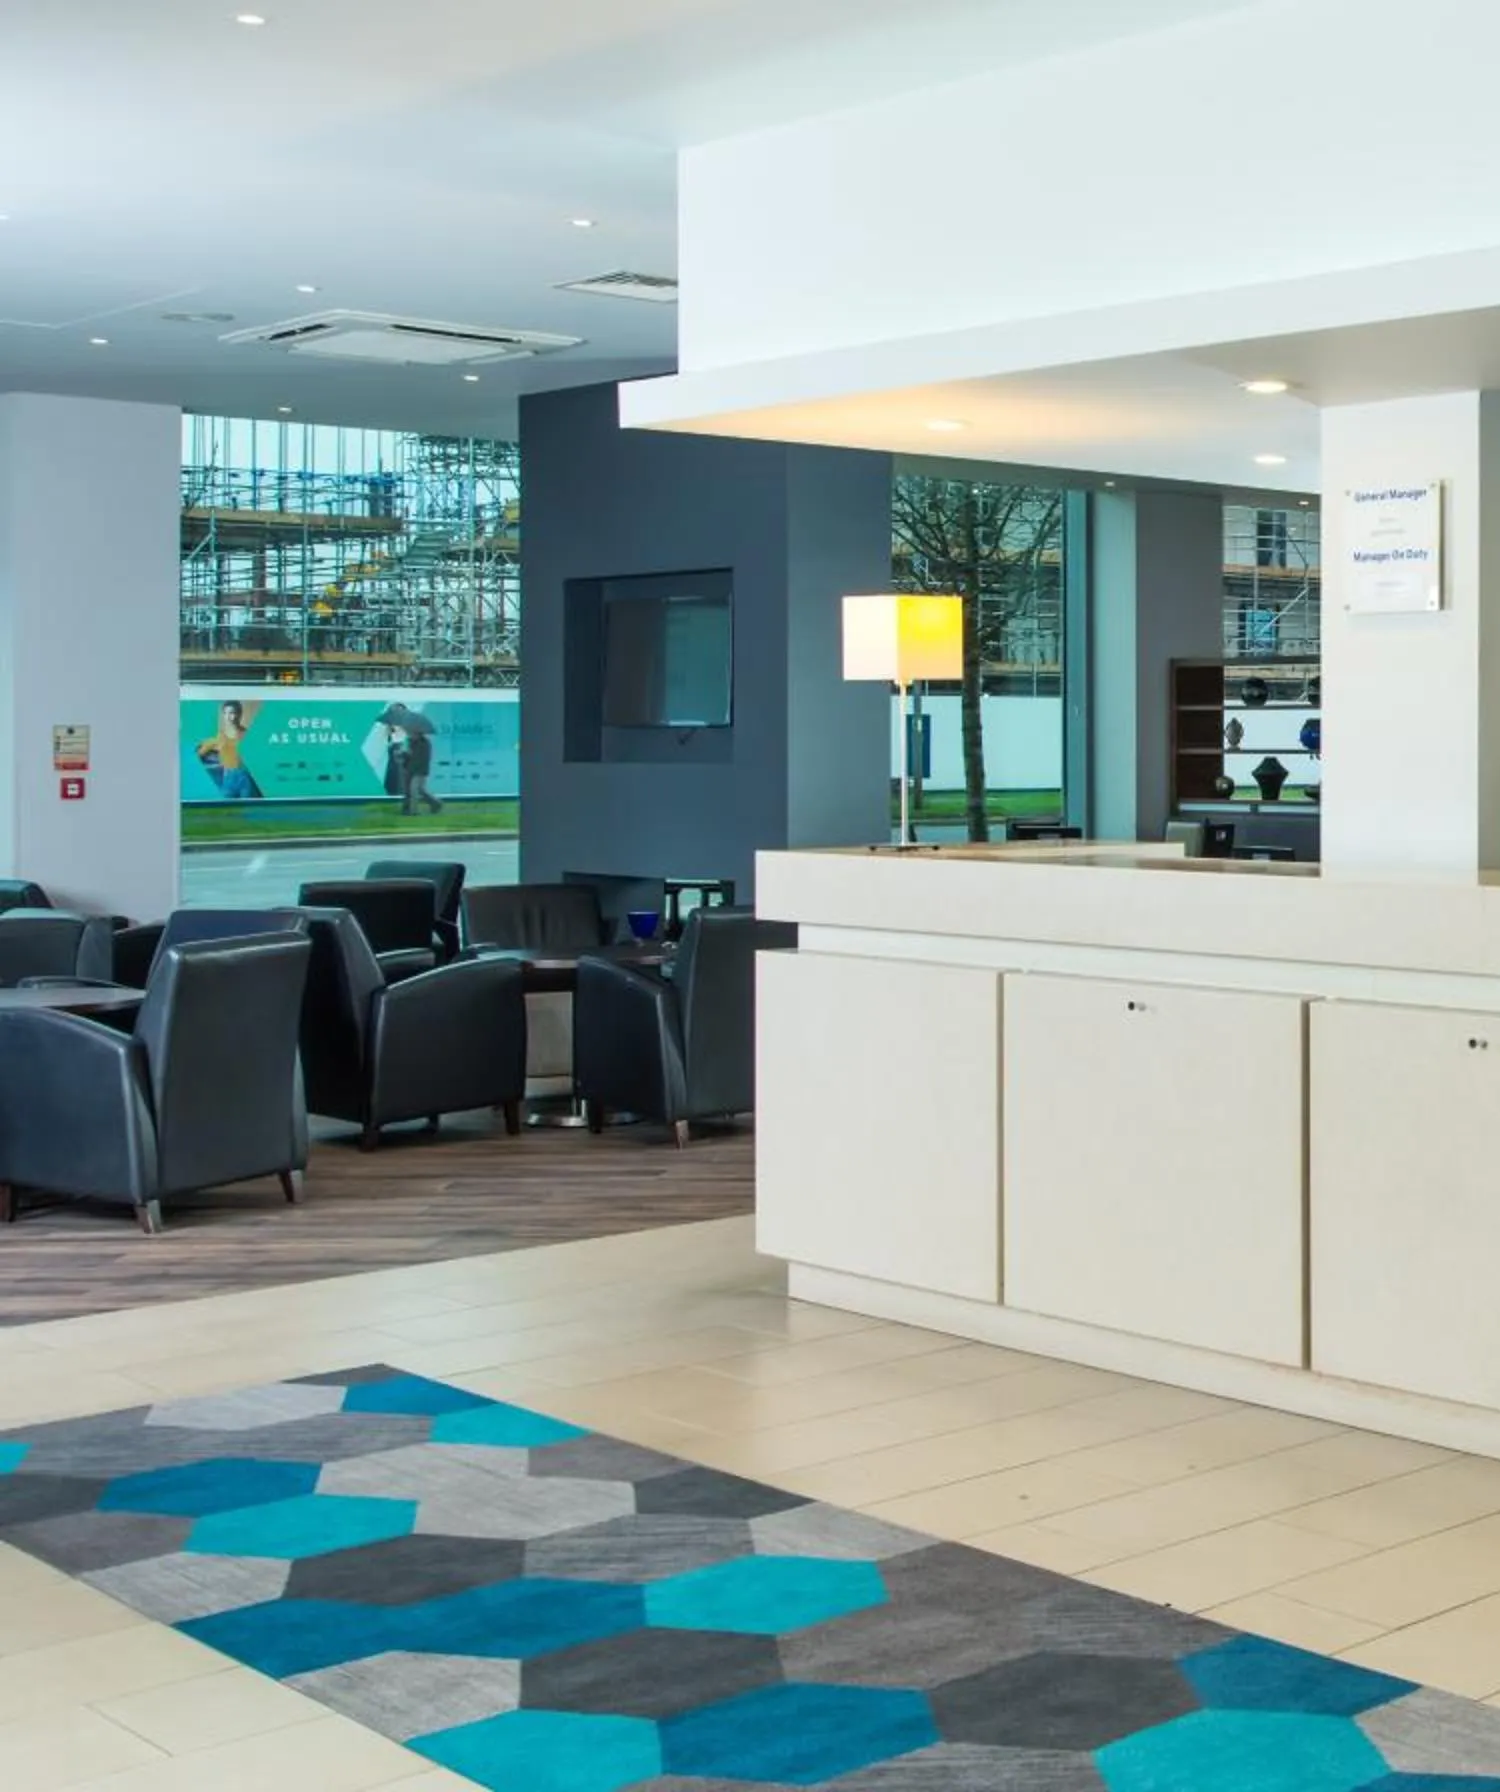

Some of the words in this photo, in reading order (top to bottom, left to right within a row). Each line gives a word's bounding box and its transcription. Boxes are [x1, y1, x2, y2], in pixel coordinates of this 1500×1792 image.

[1354, 490, 1388, 502] General
[1389, 488, 1427, 501] Manager
[1353, 551, 1390, 563] Manager
[1406, 547, 1428, 561] Duty
[287, 717, 333, 730] OPEN
[268, 732, 290, 744] AS
[297, 732, 351, 744] USUAL
